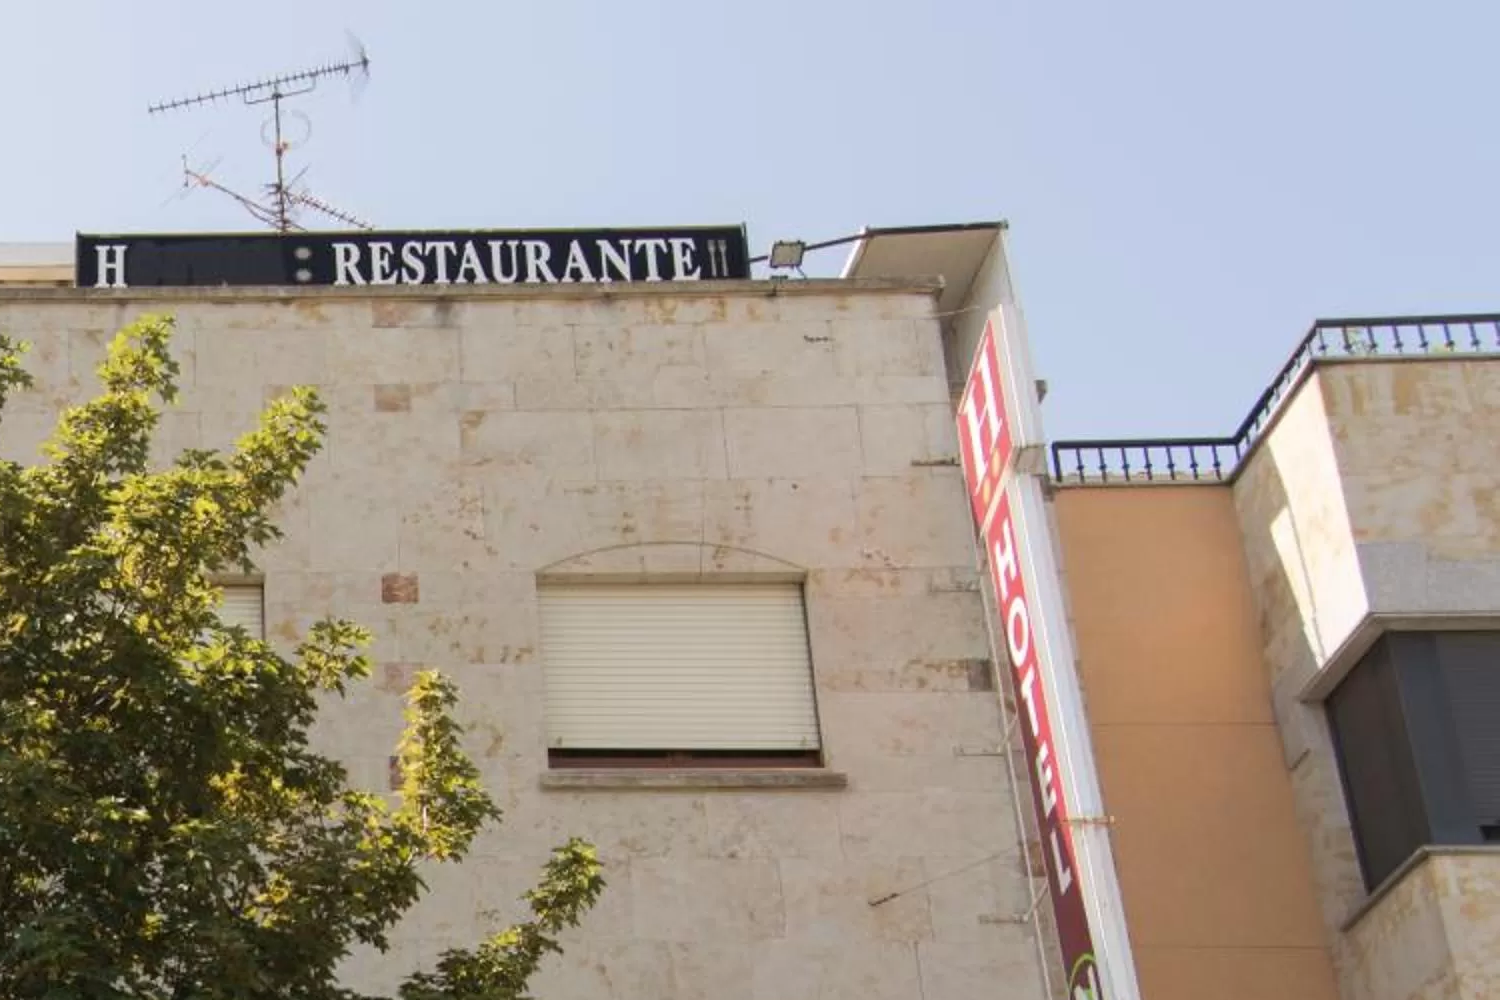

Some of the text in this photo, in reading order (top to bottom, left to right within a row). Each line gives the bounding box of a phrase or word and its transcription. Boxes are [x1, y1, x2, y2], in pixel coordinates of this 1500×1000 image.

[95, 237, 702, 288] H RESTAURANTE
[994, 523, 1074, 896] HOTEL
